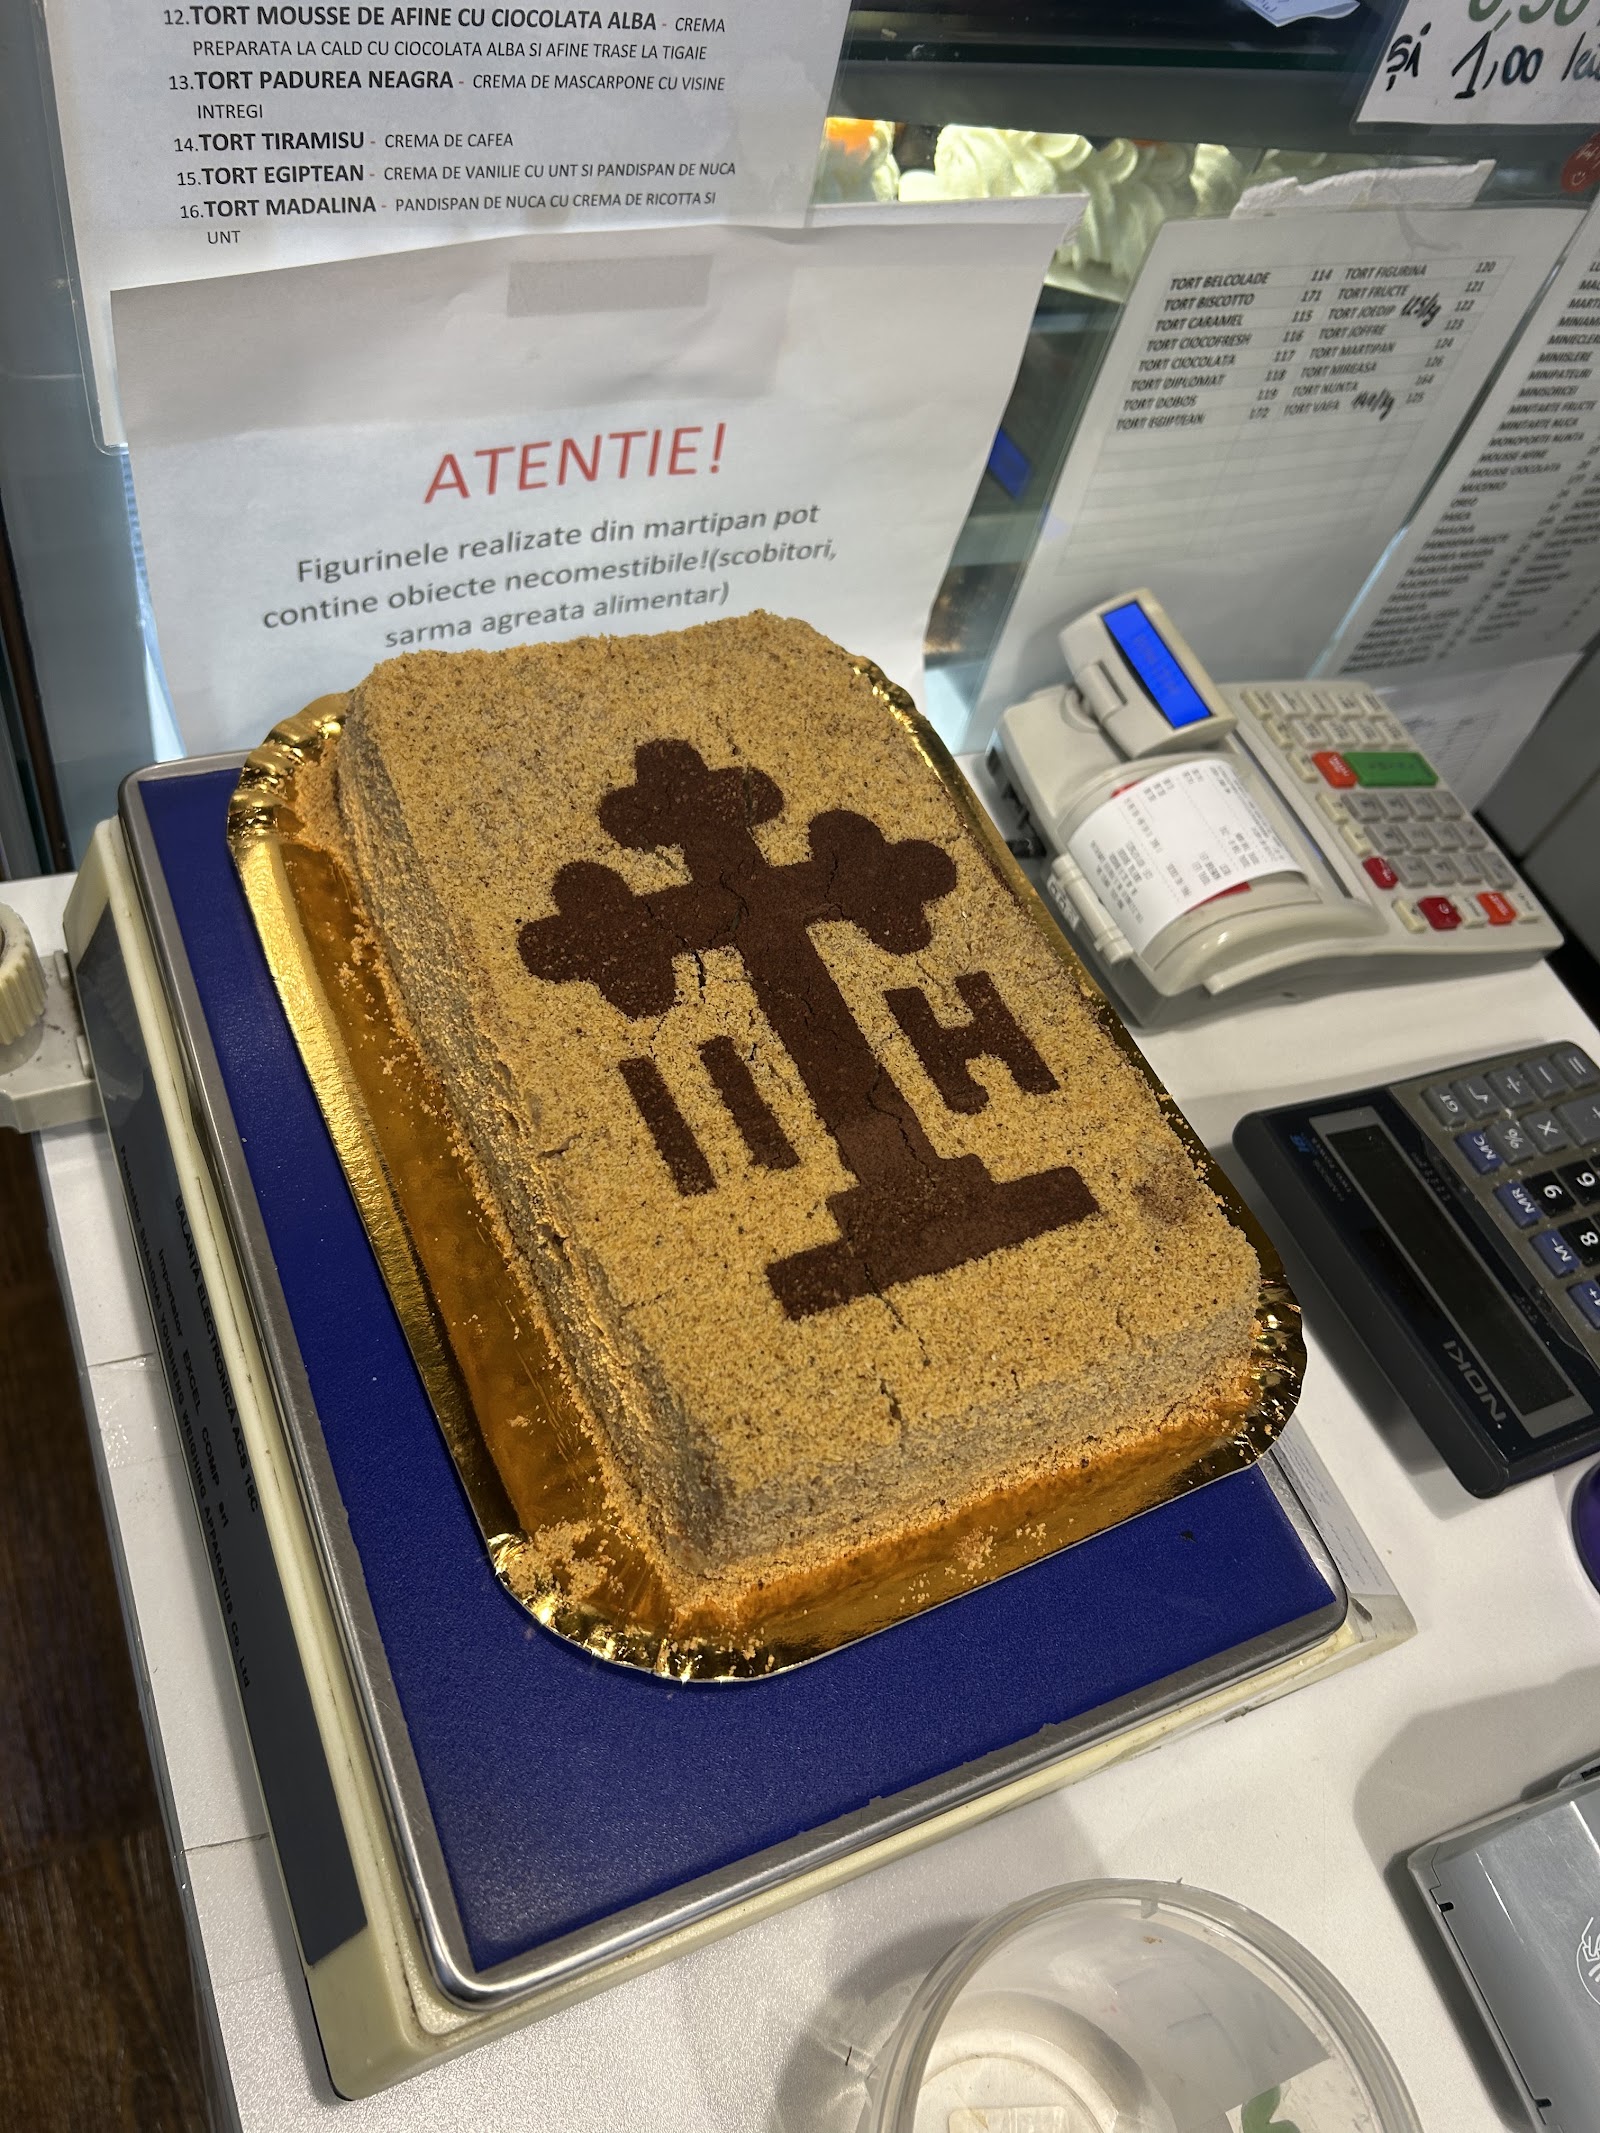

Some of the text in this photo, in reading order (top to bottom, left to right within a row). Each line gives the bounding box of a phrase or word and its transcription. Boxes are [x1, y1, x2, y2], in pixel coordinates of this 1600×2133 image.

[257, 6, 350, 26] MOUSSE
[357, 7, 384, 26] DE
[391, 7, 451, 26] AFINE
[458, 8, 485, 27] CU
[491, 9, 602, 29] CIOCOLATA
[607, 11, 656, 31] ALBA
[675, 17, 725, 33] CREMA
[193, 41, 707, 60] PREPARATA LA CALD CU CIOCOLATA ALBA SI AFINE TRASE LA TIGAIE
[1452, 30, 1544, 99] 1,00
[260, 71, 361, 89] PADUREA
[368, 71, 454, 89] NEAGRA
[473, 74, 526, 89] CREMA
[531, 75, 550, 89] DE
[554, 75, 655, 90] MASCARPONE
[658, 76, 678, 91] CU
[682, 77, 726, 91] VISINE
[197, 104, 264, 119] INTREGI
[262, 132, 364, 150] TIRAMISU
[385, 134, 439, 148] CREMA
[444, 134, 463, 148] DE
[467, 133, 514, 147] CAFEA
[264, 165, 364, 184] EGIPTEAN
[384, 167, 438, 181] CREMA
[442, 166, 461, 180] DE
[465, 165, 520, 179] VANILIE
[524, 164, 544, 178] CU
[549, 164, 578, 177] UNT
[581, 164, 593, 177] SI
[597, 163, 675, 177] PANDISPAN
[678, 163, 696, 176] DE
[699, 162, 736, 176] NUCA
[266, 196, 376, 216] MADALINA
[395, 197, 479, 211] PANDISPAN
[484, 196, 502, 210] DE
[506, 196, 545, 209] NUCA
[550, 195, 569, 208] CU
[572, 194, 622, 207] CREMA
[625, 193, 642, 206] DE
[646, 192, 701, 206] RICOTTA
[704, 192, 716, 204] SI
[207, 230, 241, 244] UNT
[1170, 261, 1497, 290] TORT BELCOLADE 114 TORT FIGURINA 120
[1164, 280, 1485, 312] TORT BISCOTTO 171 TORT FRUCTE 121
[1155, 317, 1188, 332] TORT
[1187, 314, 1244, 329] CARAMEL
[1291, 310, 1314, 323] 115
[1328, 307, 1358, 320] TORT
[1454, 299, 1475, 312] 122
[1146, 337, 1179, 352] TORT
[1282, 330, 1304, 343] 116
[1318, 327, 1348, 340] TORT
[1138, 358, 1170, 372] TORT
[1170, 354, 1236, 370] CIOCOLATA
[1273, 350, 1296, 363] 117
[1309, 347, 1339, 360] TORT
[1339, 342, 1397, 357] MARTIPAN
[1130, 378, 1162, 392] TORT
[1162, 374, 1227, 390] DIPLOMAT
[1300, 366, 1330, 379] TORT
[1329, 361, 1377, 376] MIREASA
[423, 422, 727, 504] ATENTIE!
[298, 504, 820, 584] Figurinele realizate din martipan pot
[263, 595, 378, 629] contine
[388, 576, 496, 609] obiecte
[385, 581, 730, 648] sarma agreata alimentar)
[1439, 1093, 1459, 1113] GT
[1473, 1134, 1496, 1161] MC
[1543, 1183, 1563, 1199] 9
[1576, 1171, 1596, 1188] 6
[1511, 1187, 1535, 1214] MR
[1580, 1231, 1599, 1246] 8
[1442, 1341, 1507, 1424] NOKI
